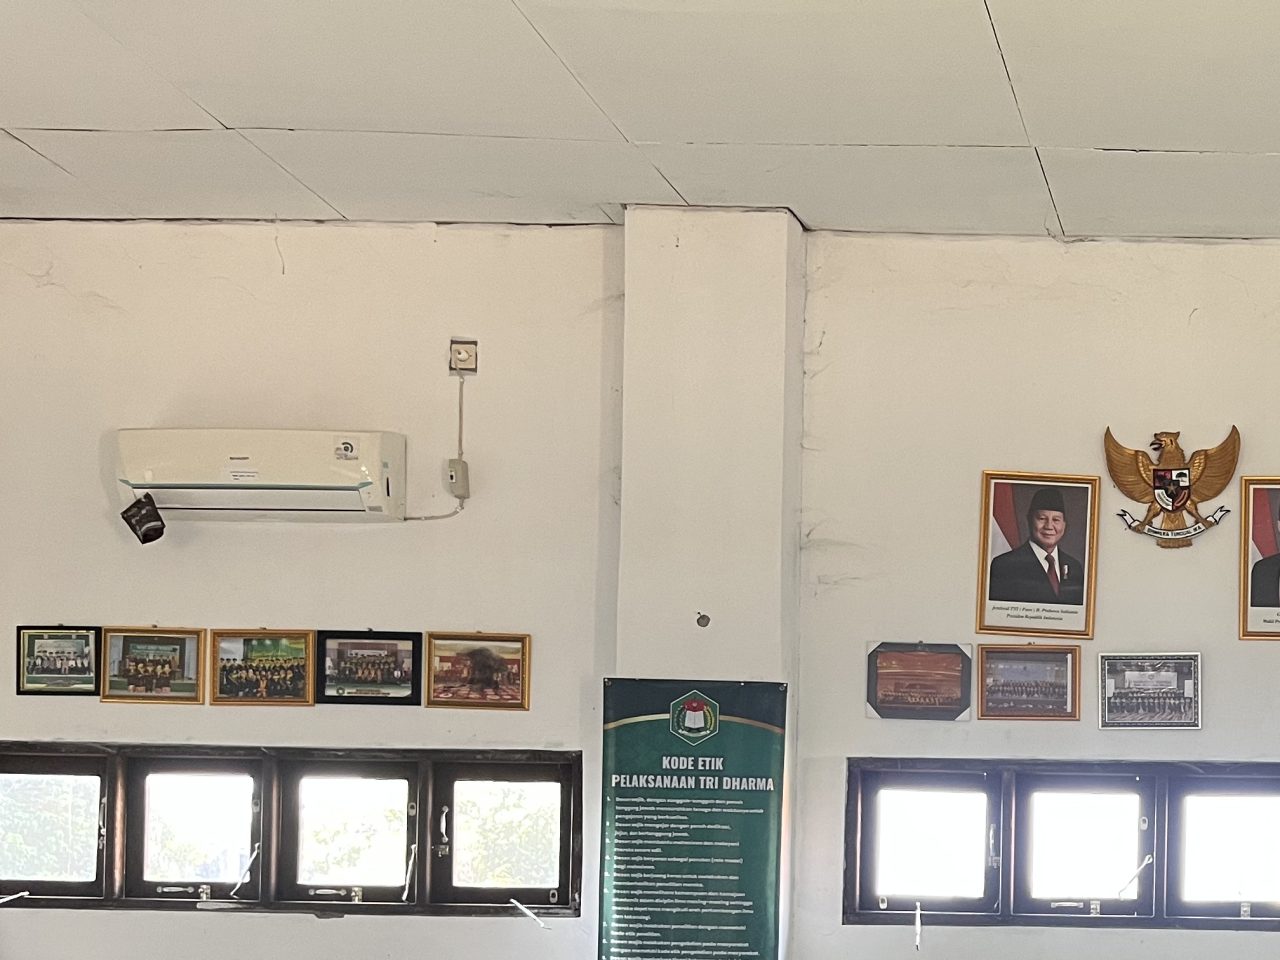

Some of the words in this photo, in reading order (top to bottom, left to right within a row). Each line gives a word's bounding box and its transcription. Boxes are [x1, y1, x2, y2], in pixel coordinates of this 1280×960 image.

[662, 756, 694, 770] KODE
[698, 757, 724, 770] ETIK
[611, 774, 695, 789] PELAKSANAAN
[699, 776, 718, 790] TRI
[723, 777, 774, 791] DHARMA
